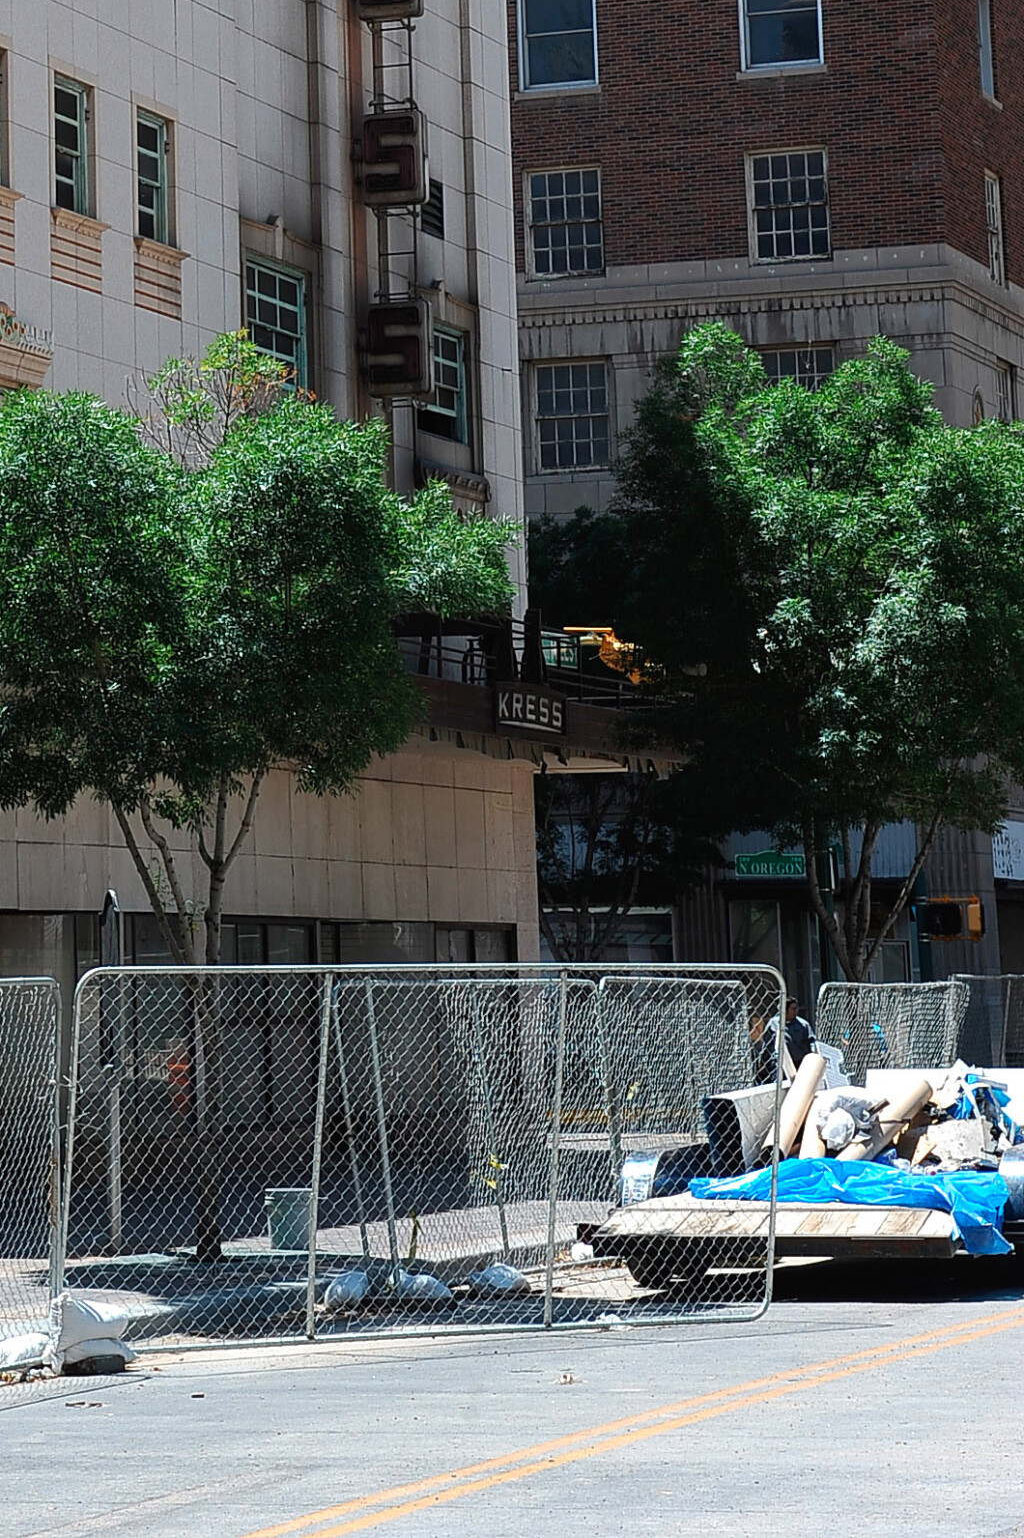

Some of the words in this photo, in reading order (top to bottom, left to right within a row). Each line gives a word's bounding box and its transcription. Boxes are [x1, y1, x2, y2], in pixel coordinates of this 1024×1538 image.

[498, 691, 563, 728] KRESS
[739, 862, 748, 875] N
[750, 862, 804, 875] OREGON
